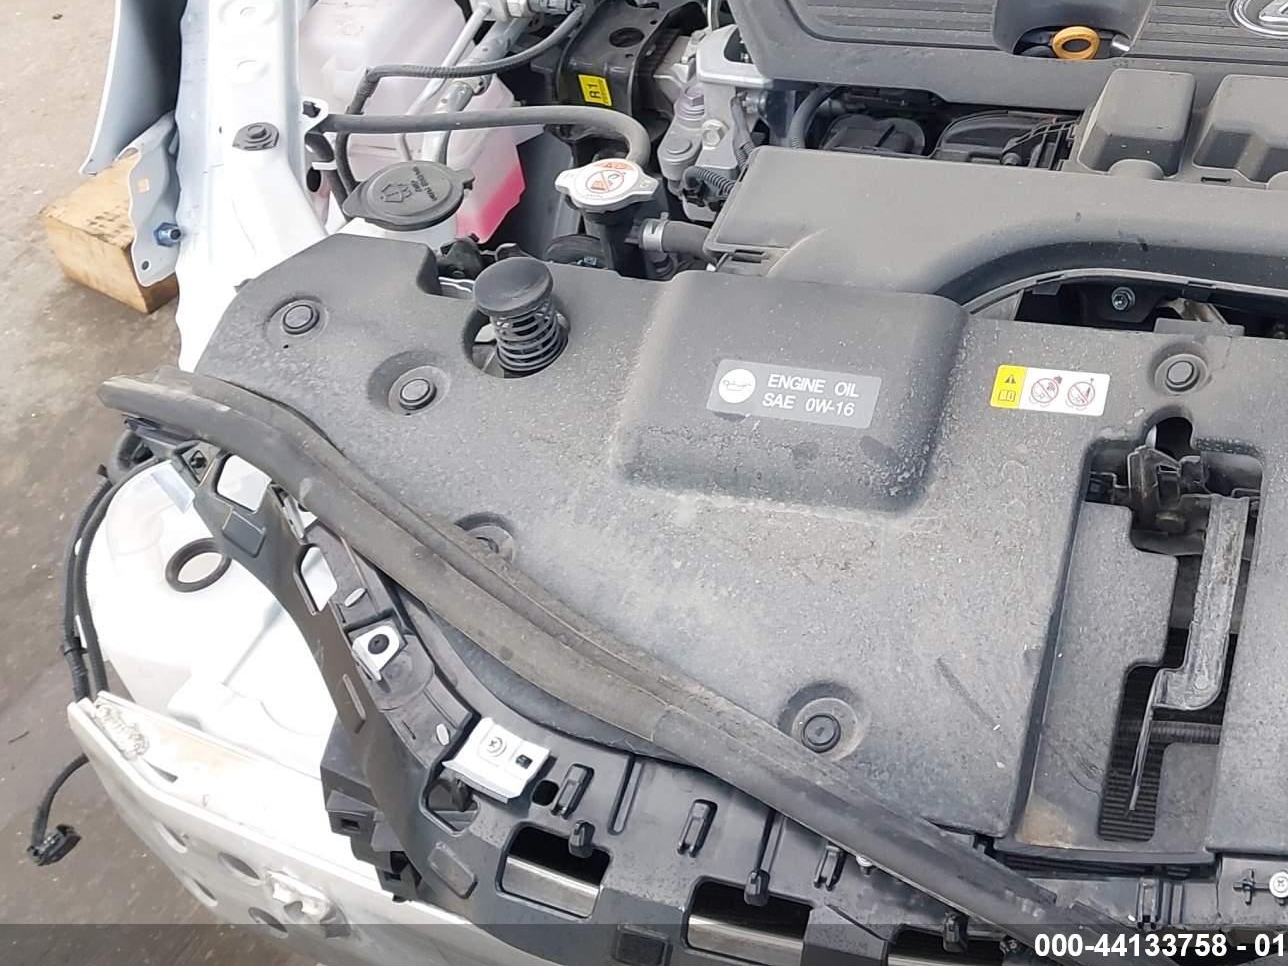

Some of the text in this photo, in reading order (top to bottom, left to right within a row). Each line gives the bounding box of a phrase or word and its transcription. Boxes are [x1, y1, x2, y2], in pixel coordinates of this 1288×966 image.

[767, 373, 860, 398] ENGINE OIL
[762, 392, 855, 417] SAE 0W-16
